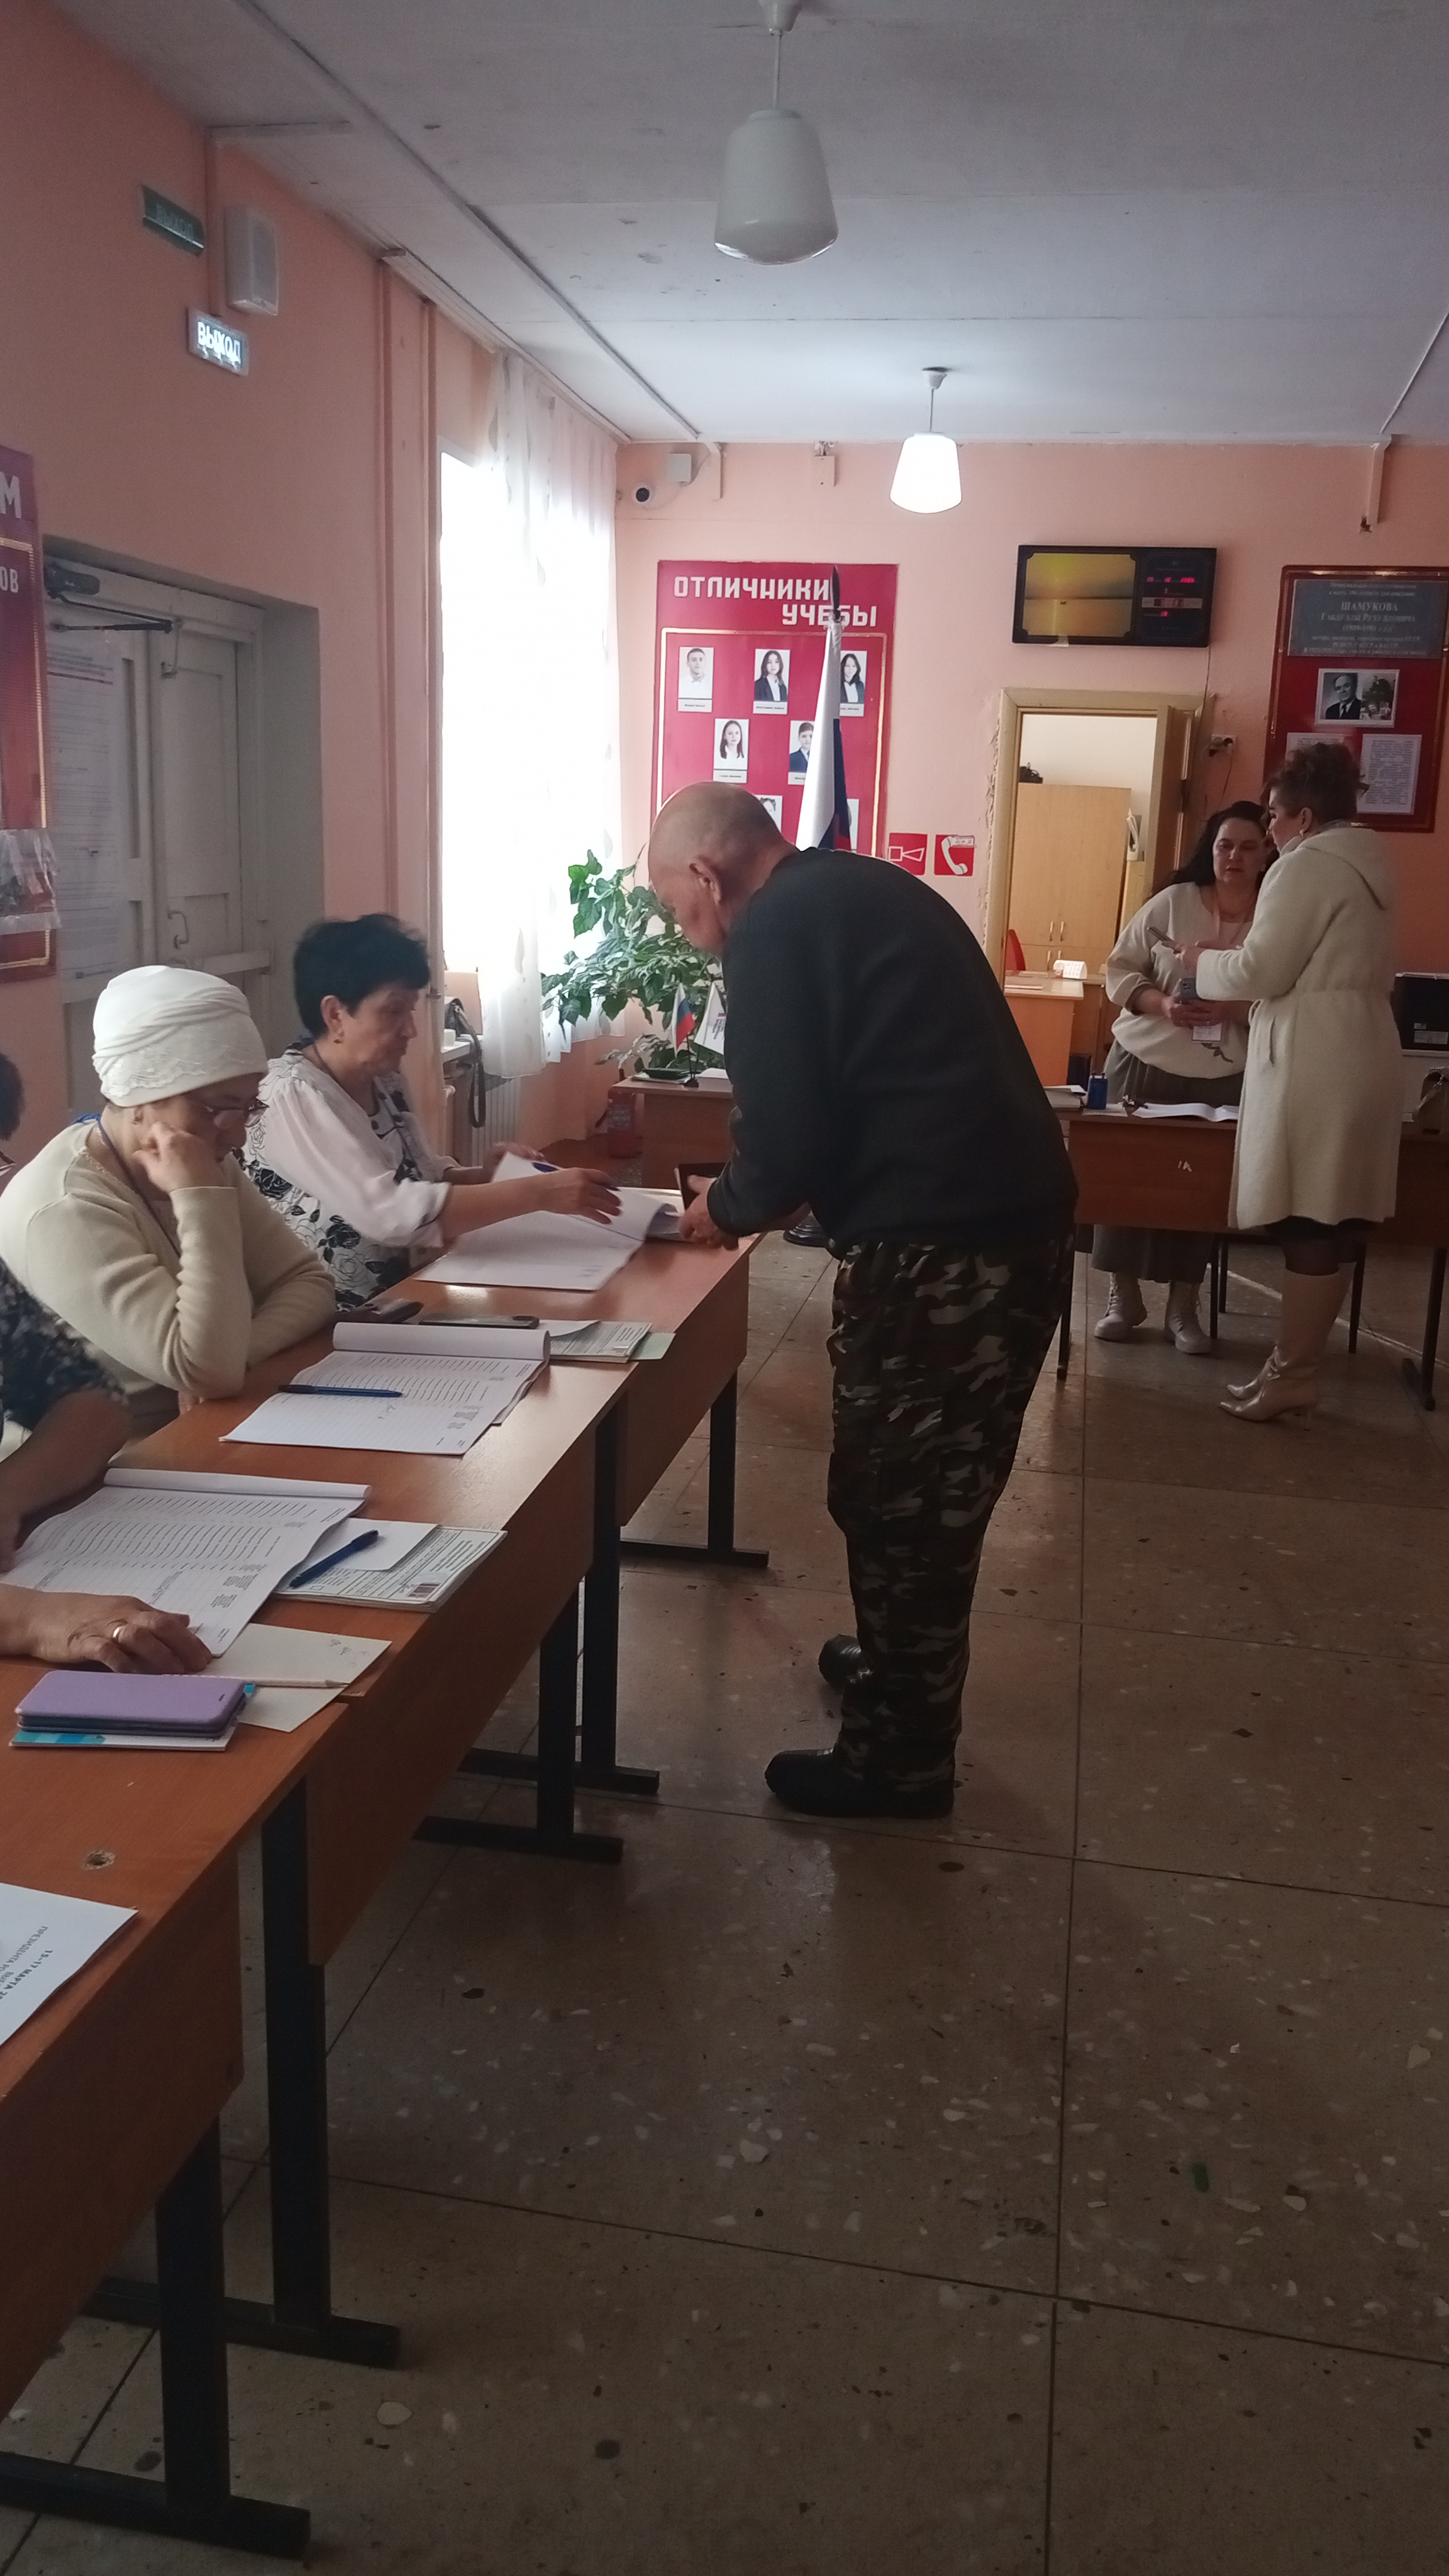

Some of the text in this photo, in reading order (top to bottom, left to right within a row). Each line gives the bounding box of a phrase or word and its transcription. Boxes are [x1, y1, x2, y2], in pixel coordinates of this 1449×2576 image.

[197, 321, 242, 365] ВЫХОД
[674, 575, 830, 601] ОТЛИЧНИКИ
[782, 604, 877, 627] УЧЕБЫ
[1340, 601, 1399, 612] ШАМУКОВА
[6, 1926, 48, 1963] ПРЕЗИДЕНТА
[30, 1950, 53, 1968] 15-17
[4, 1968, 33, 1989] МАРТА
